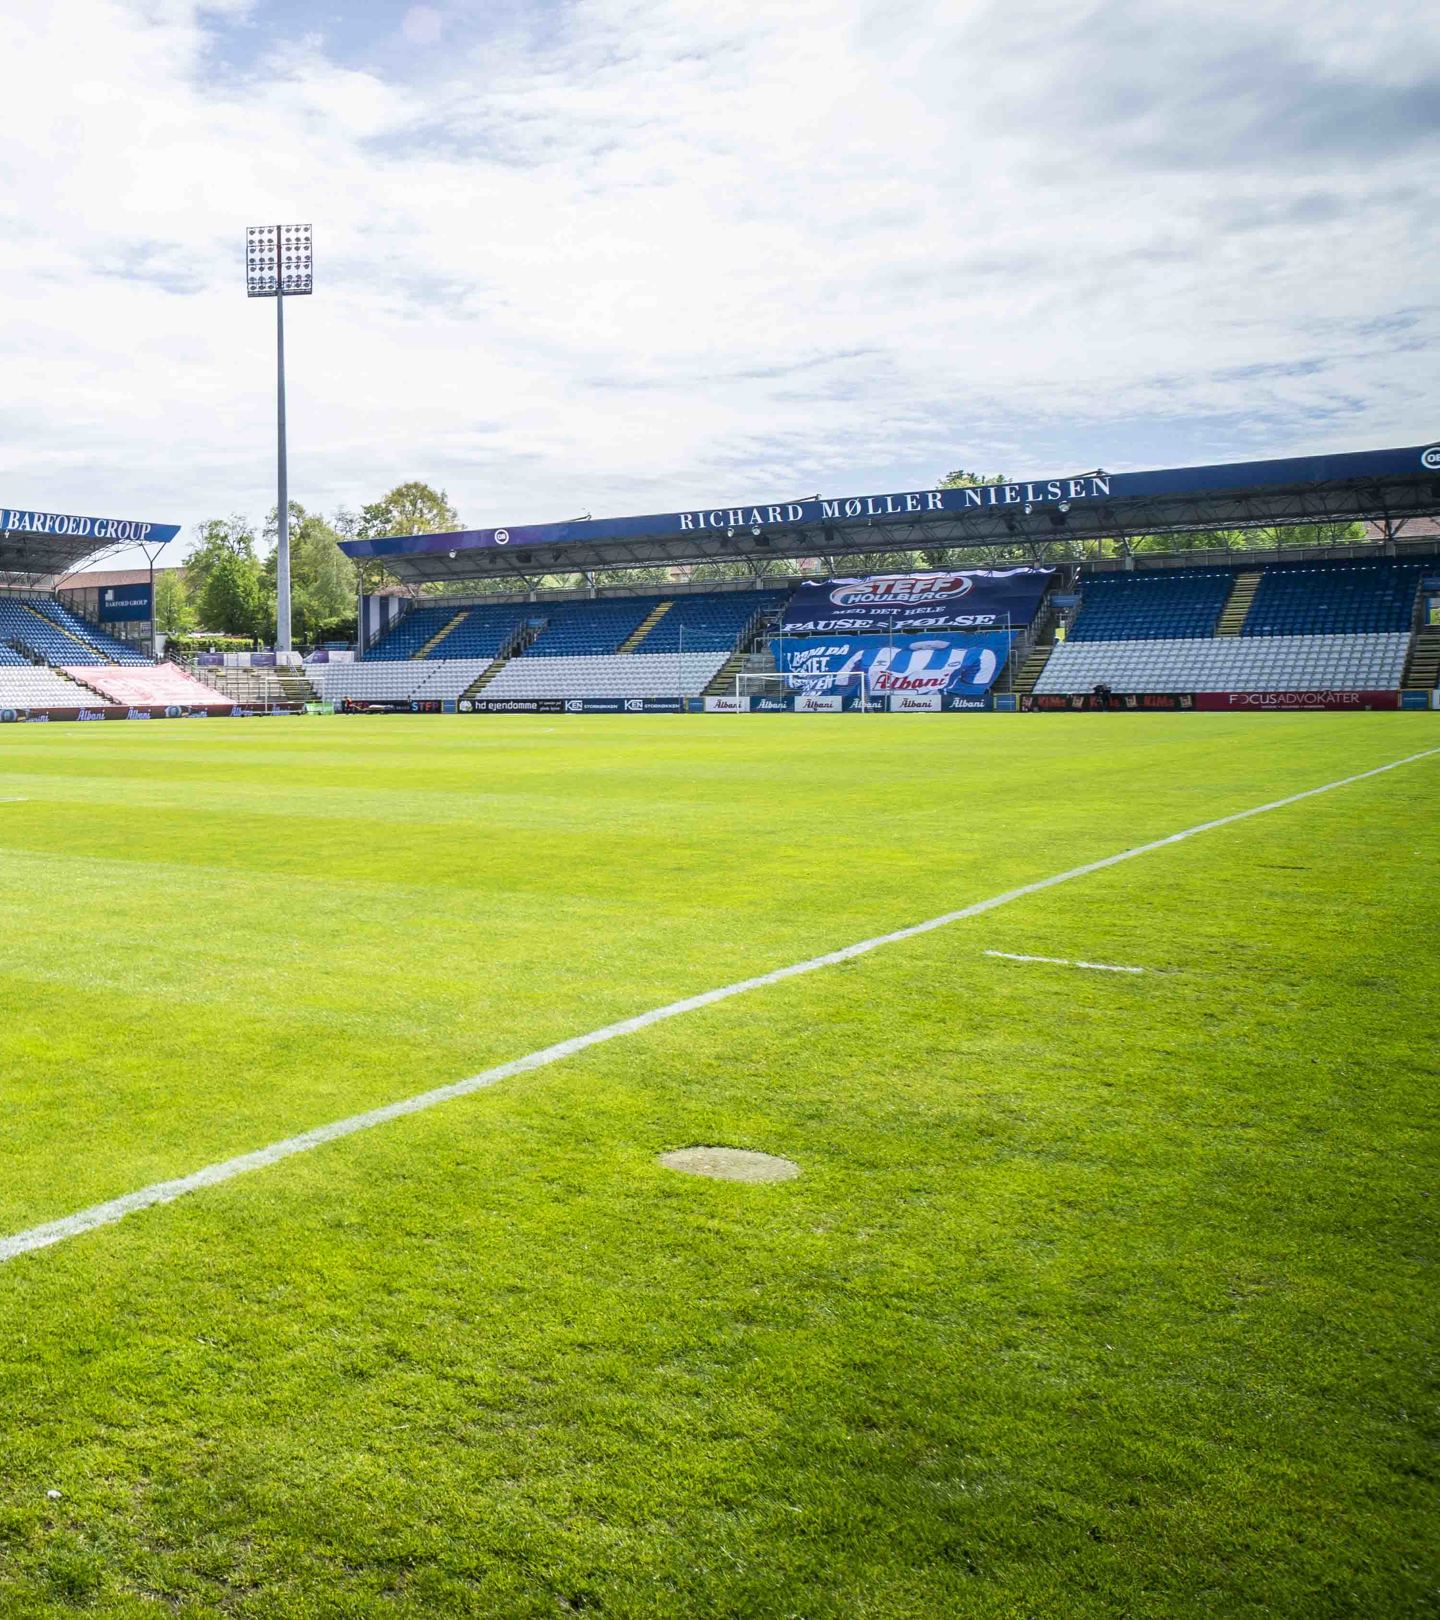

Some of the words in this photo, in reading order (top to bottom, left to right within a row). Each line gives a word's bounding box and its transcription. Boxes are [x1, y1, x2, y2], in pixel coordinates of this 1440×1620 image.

[679, 504, 805, 530] RICHARD
[820, 491, 944, 519] MØLLER
[964, 476, 1112, 508] NIELSEN
[7, 510, 92, 537] BARFOED
[93, 518, 152, 541] GROUP
[860, 578, 954, 594] STEFF
[847, 591, 951, 605] HOULBERG
[903, 606, 946, 615] HELE
[783, 619, 875, 632] PAUSE
[891, 614, 997, 630] PØLSE
[875, 671, 950, 691] Albani
[474, 700, 486, 710] hd
[488, 701, 538, 711] ejendomme
